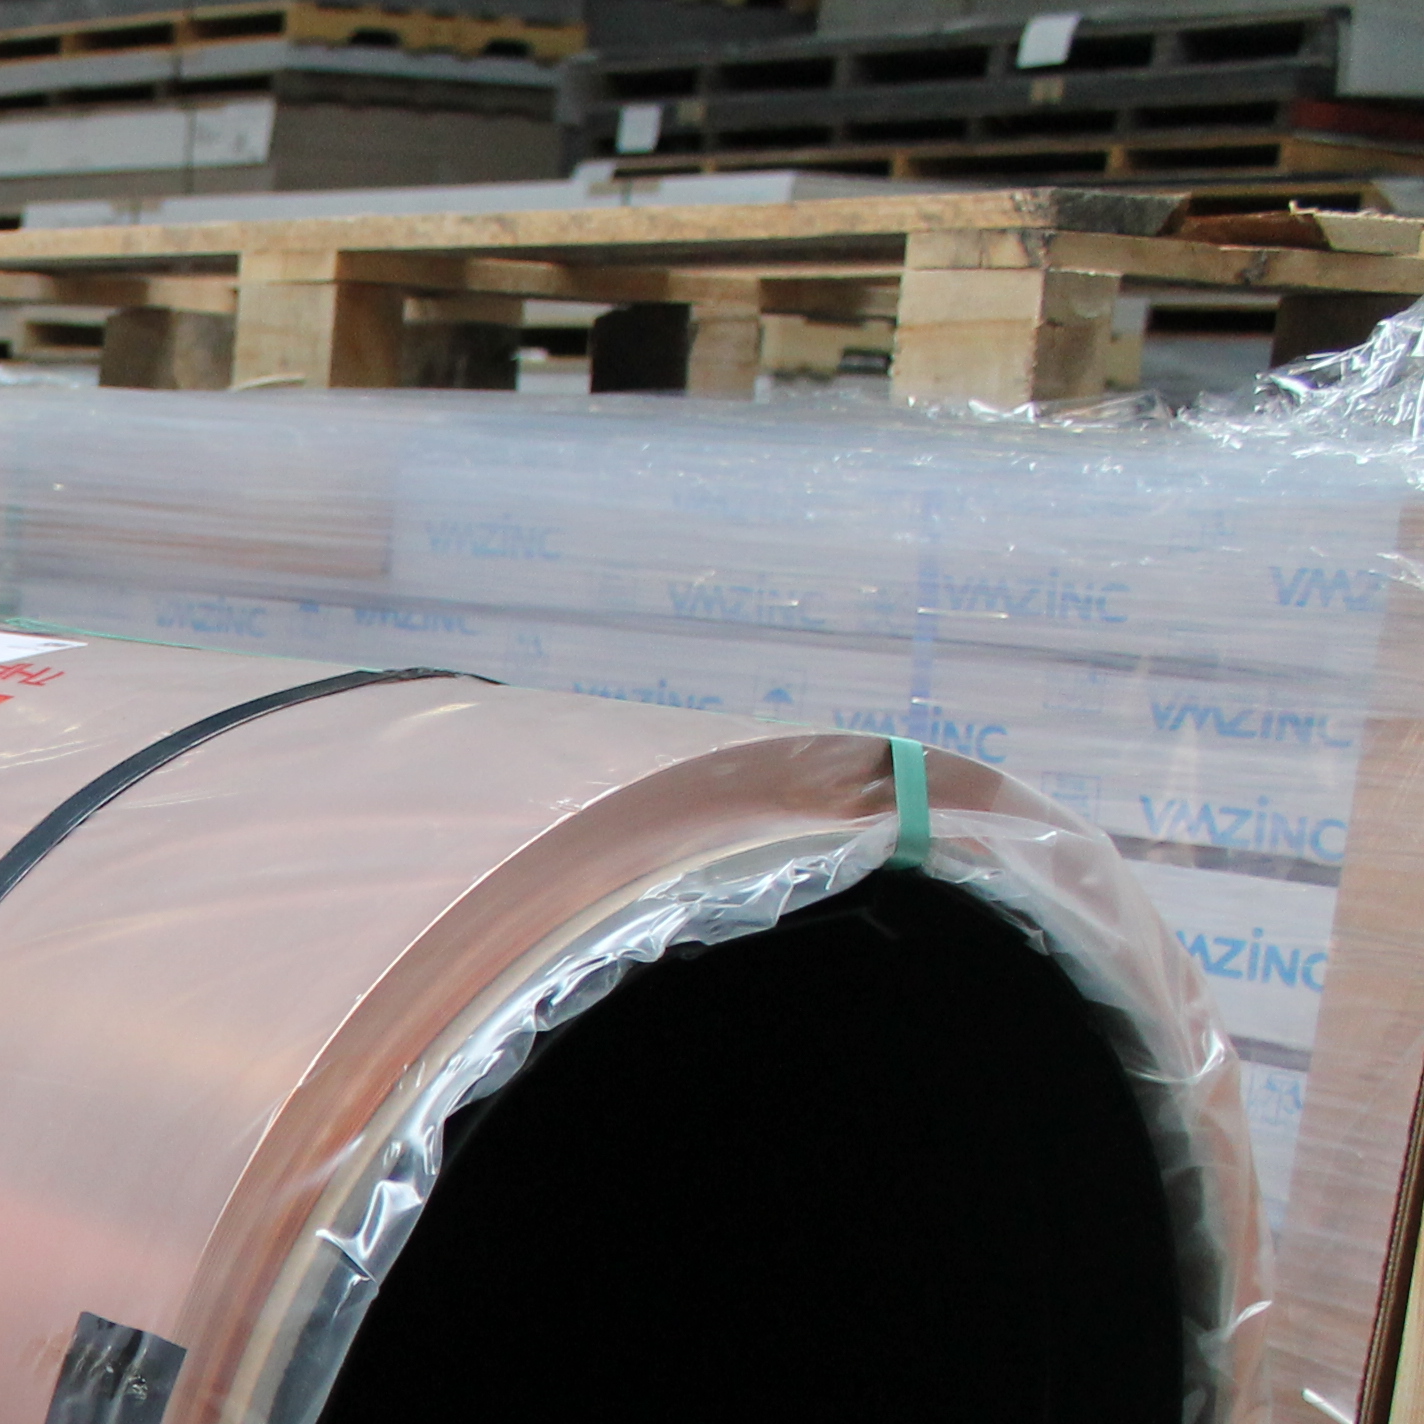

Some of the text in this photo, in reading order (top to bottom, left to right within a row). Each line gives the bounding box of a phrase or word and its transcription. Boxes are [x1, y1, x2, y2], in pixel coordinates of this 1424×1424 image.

[942, 568, 1129, 624] VMZINC
[572, 677, 724, 711] ZINC
[1140, 795, 1346, 864] VMZINC
[1176, 926, 1328, 993] MZINC
